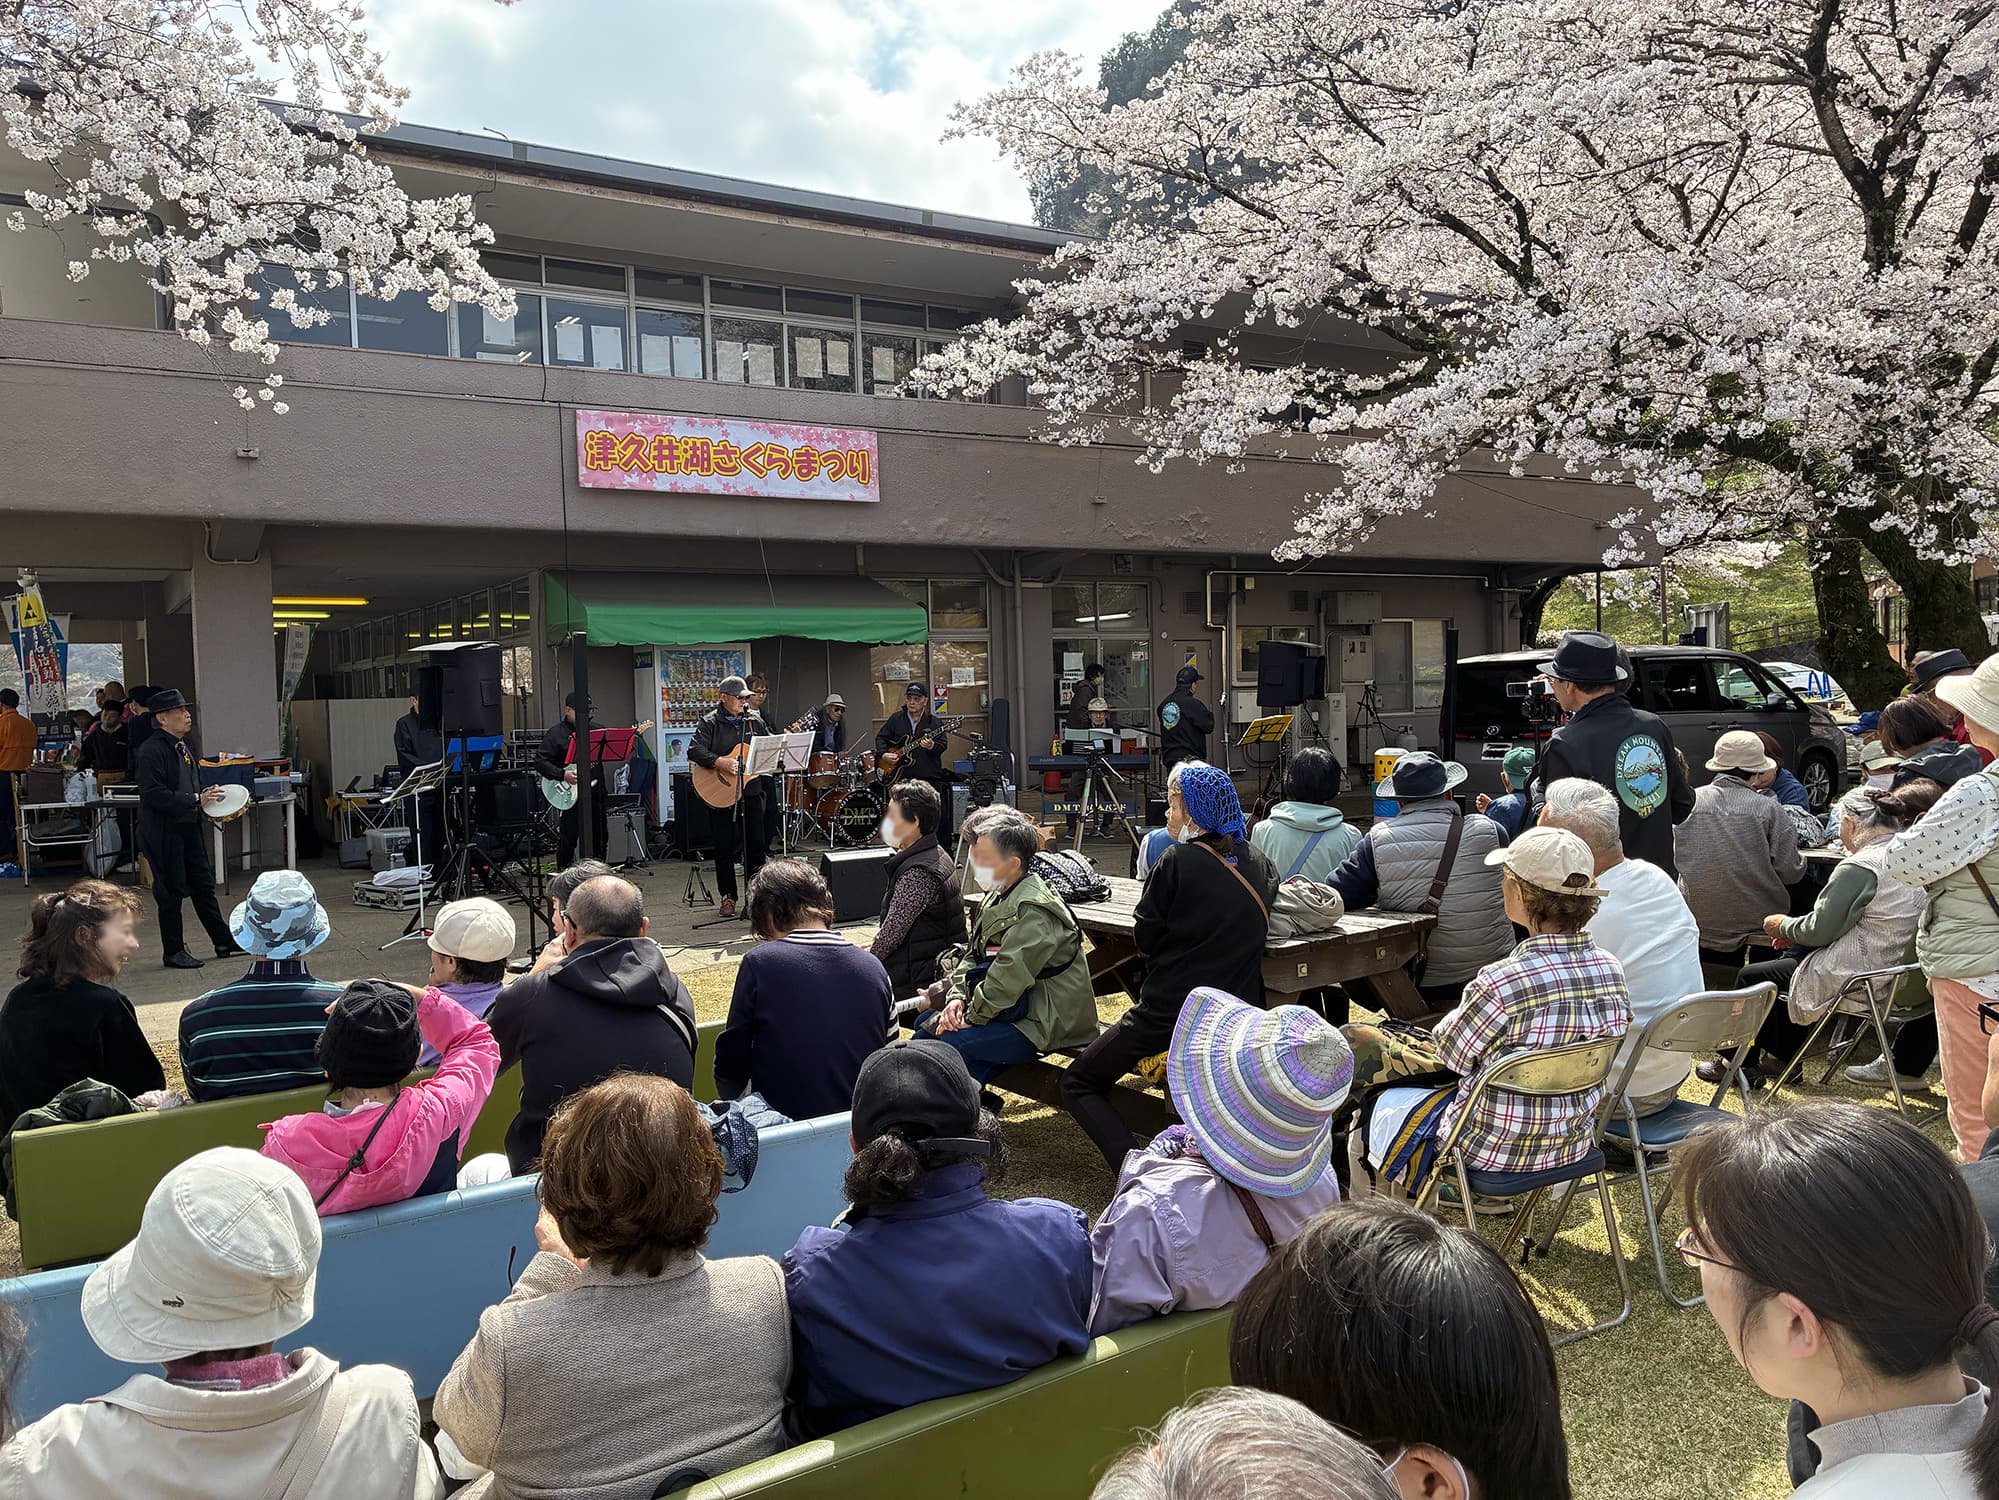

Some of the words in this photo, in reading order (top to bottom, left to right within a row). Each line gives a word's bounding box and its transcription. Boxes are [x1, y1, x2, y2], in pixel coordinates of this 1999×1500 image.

[585, 430, 871, 484] 津久井湖さくらまつり
[1617, 744, 1631, 778] DREAM
[843, 808, 876, 826] DMT
